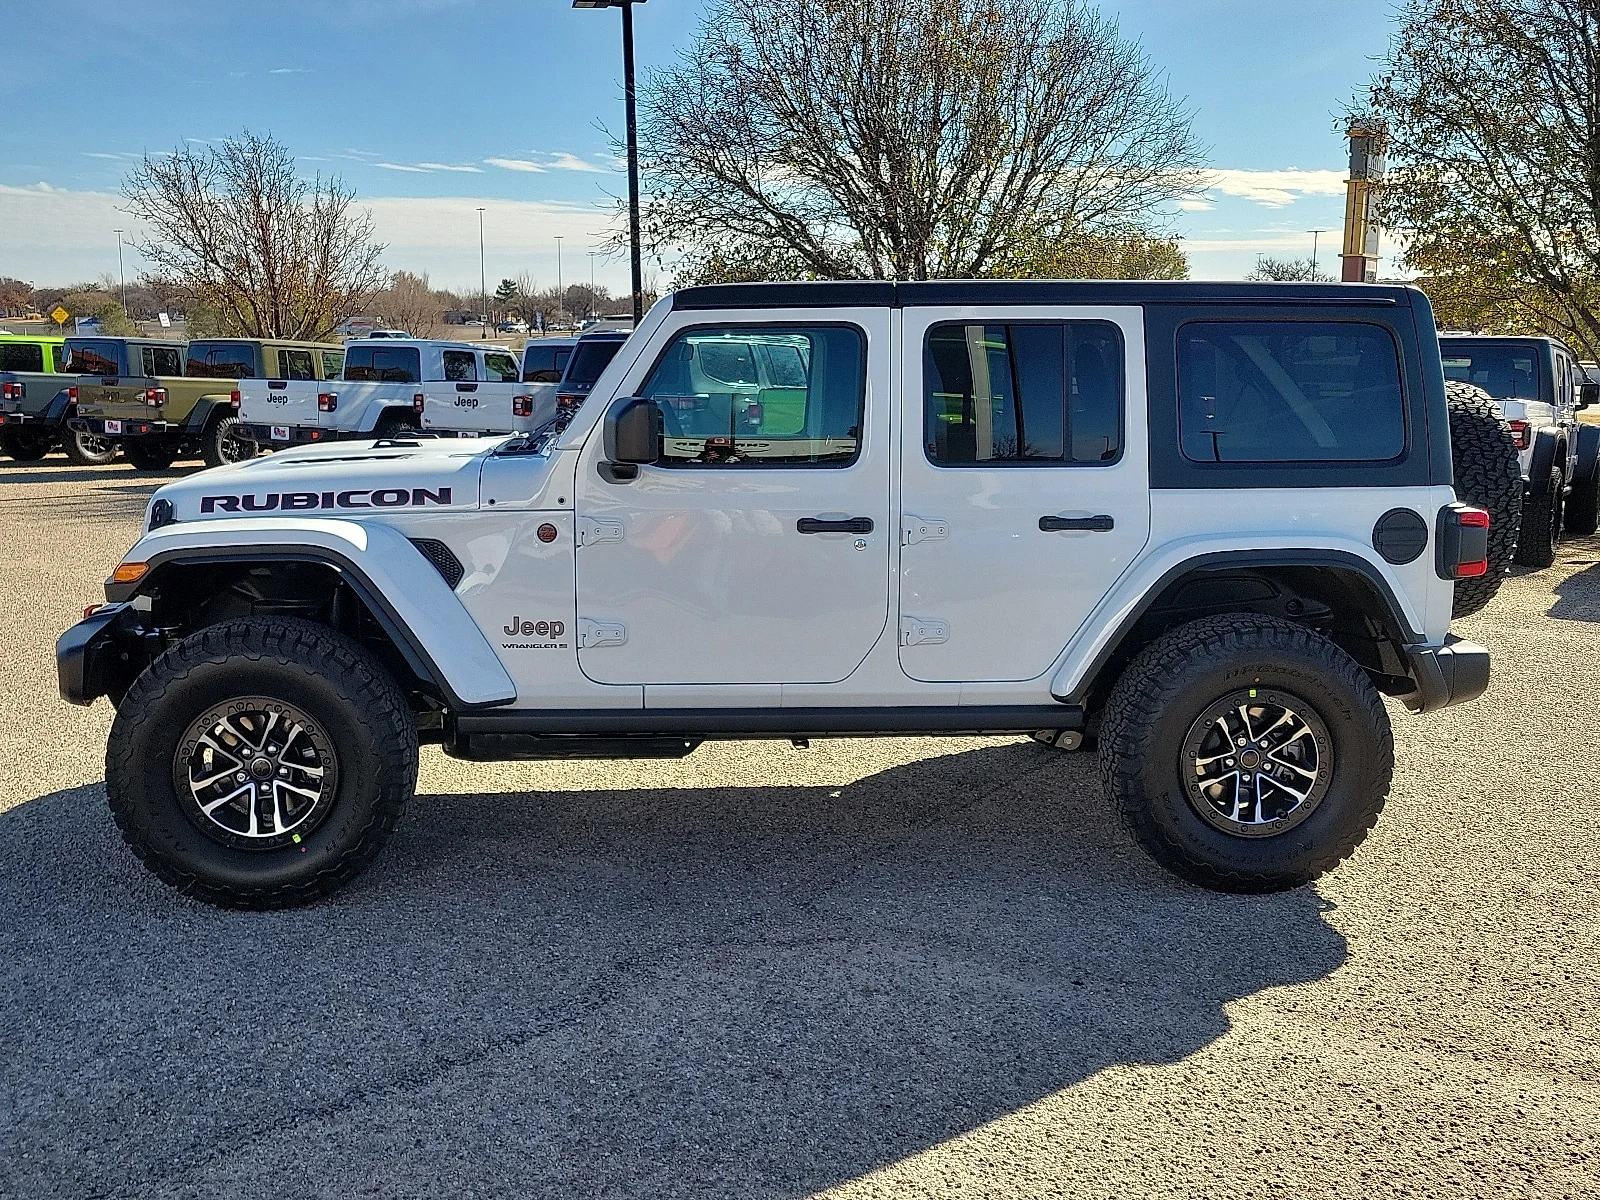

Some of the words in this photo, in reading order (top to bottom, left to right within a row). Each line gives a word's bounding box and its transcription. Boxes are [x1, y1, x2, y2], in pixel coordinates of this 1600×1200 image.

[266, 393, 288, 405] Jeep
[454, 395, 479, 409] Jeep
[200, 487, 452, 513] RUBICON
[503, 616, 565, 639] Jeep
